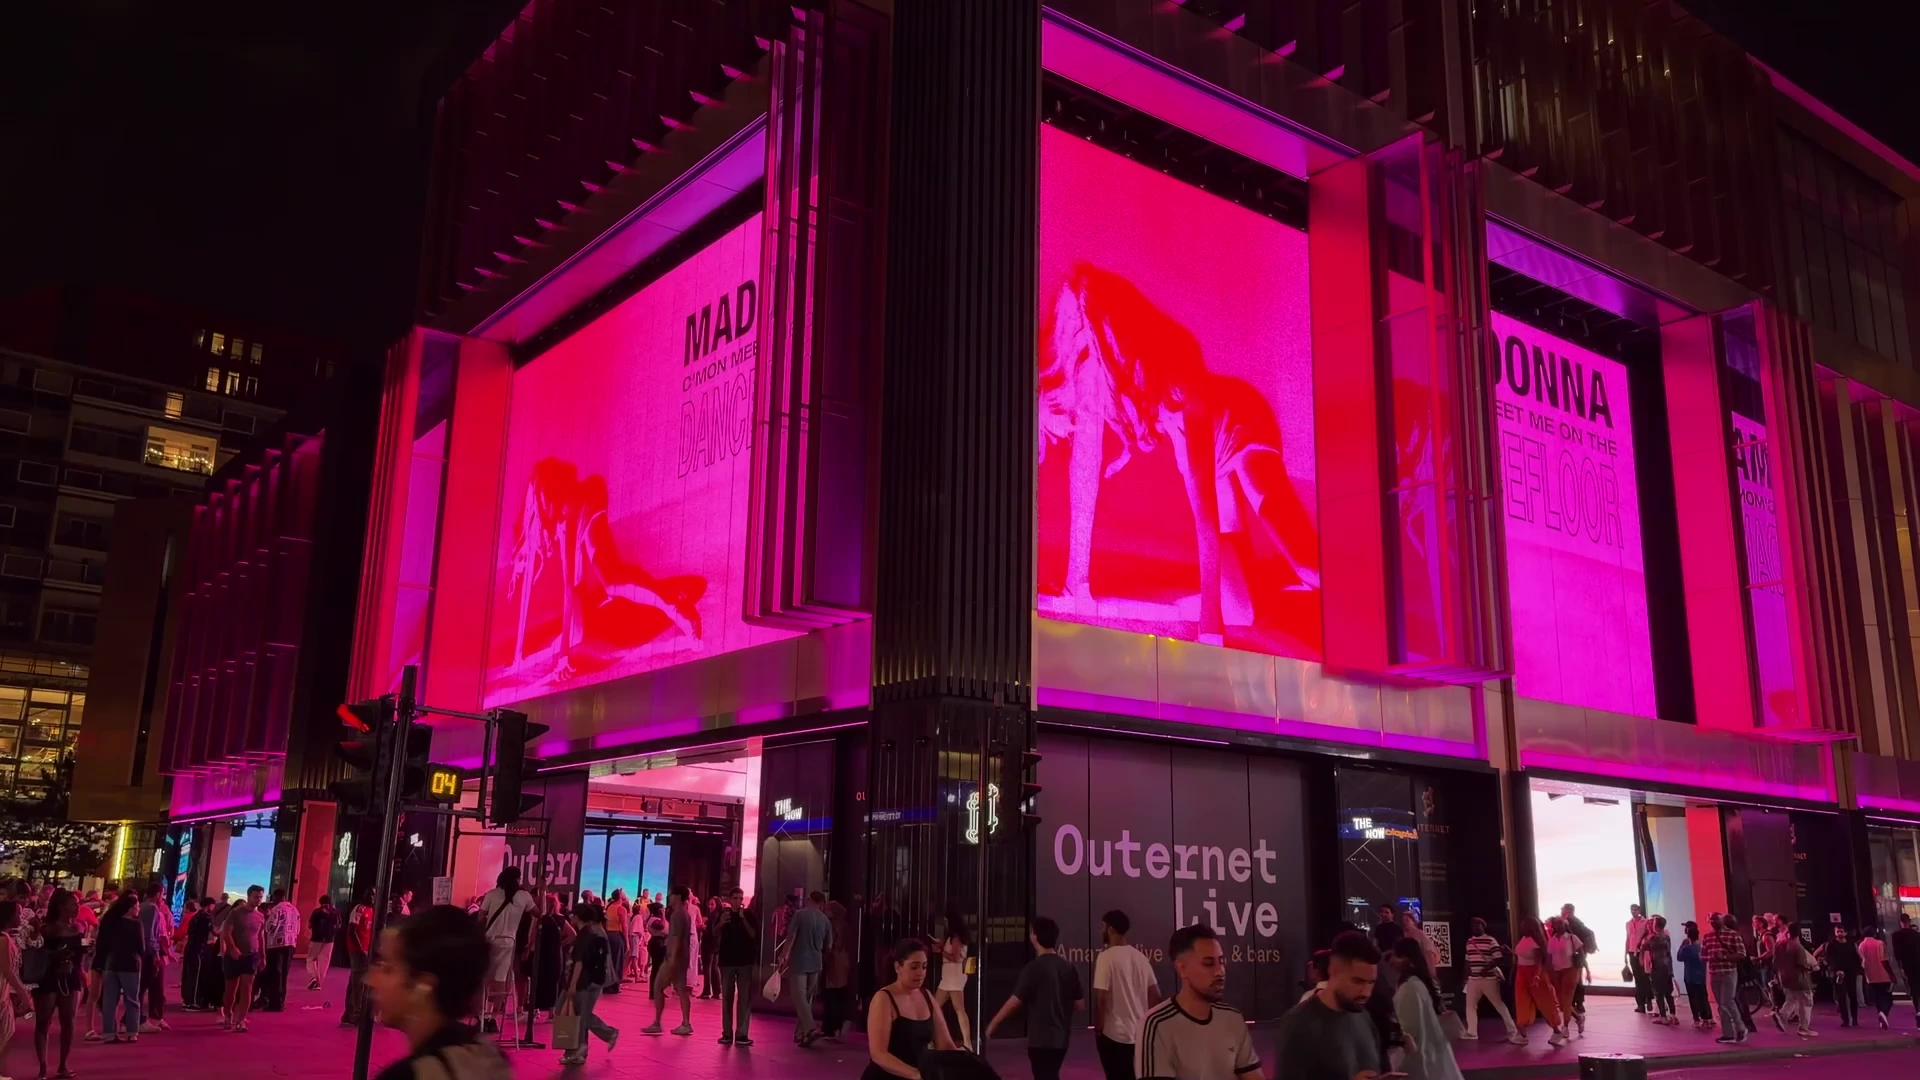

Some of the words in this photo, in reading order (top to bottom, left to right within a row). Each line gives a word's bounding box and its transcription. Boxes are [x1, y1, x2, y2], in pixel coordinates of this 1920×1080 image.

[683, 280, 757, 367] MAD
[682, 361, 727, 392] C'MON
[1529, 411, 1555, 435] ME
[1559, 420, 1583, 444] ON
[1585, 432, 1618, 458] THE
[1502, 430, 1624, 550] EFLOOR
[431, 772, 457, 795] 04
[774, 797, 792, 817] THE
[784, 807, 803, 820] NOW
[1352, 817, 1372, 831] THE
[1365, 827, 1385, 839] NOW
[1054, 823, 1277, 884] Outernet
[1174, 887, 1278, 937] Live
[1231, 944, 1243, 963] &
[1246, 944, 1280, 963] bars
